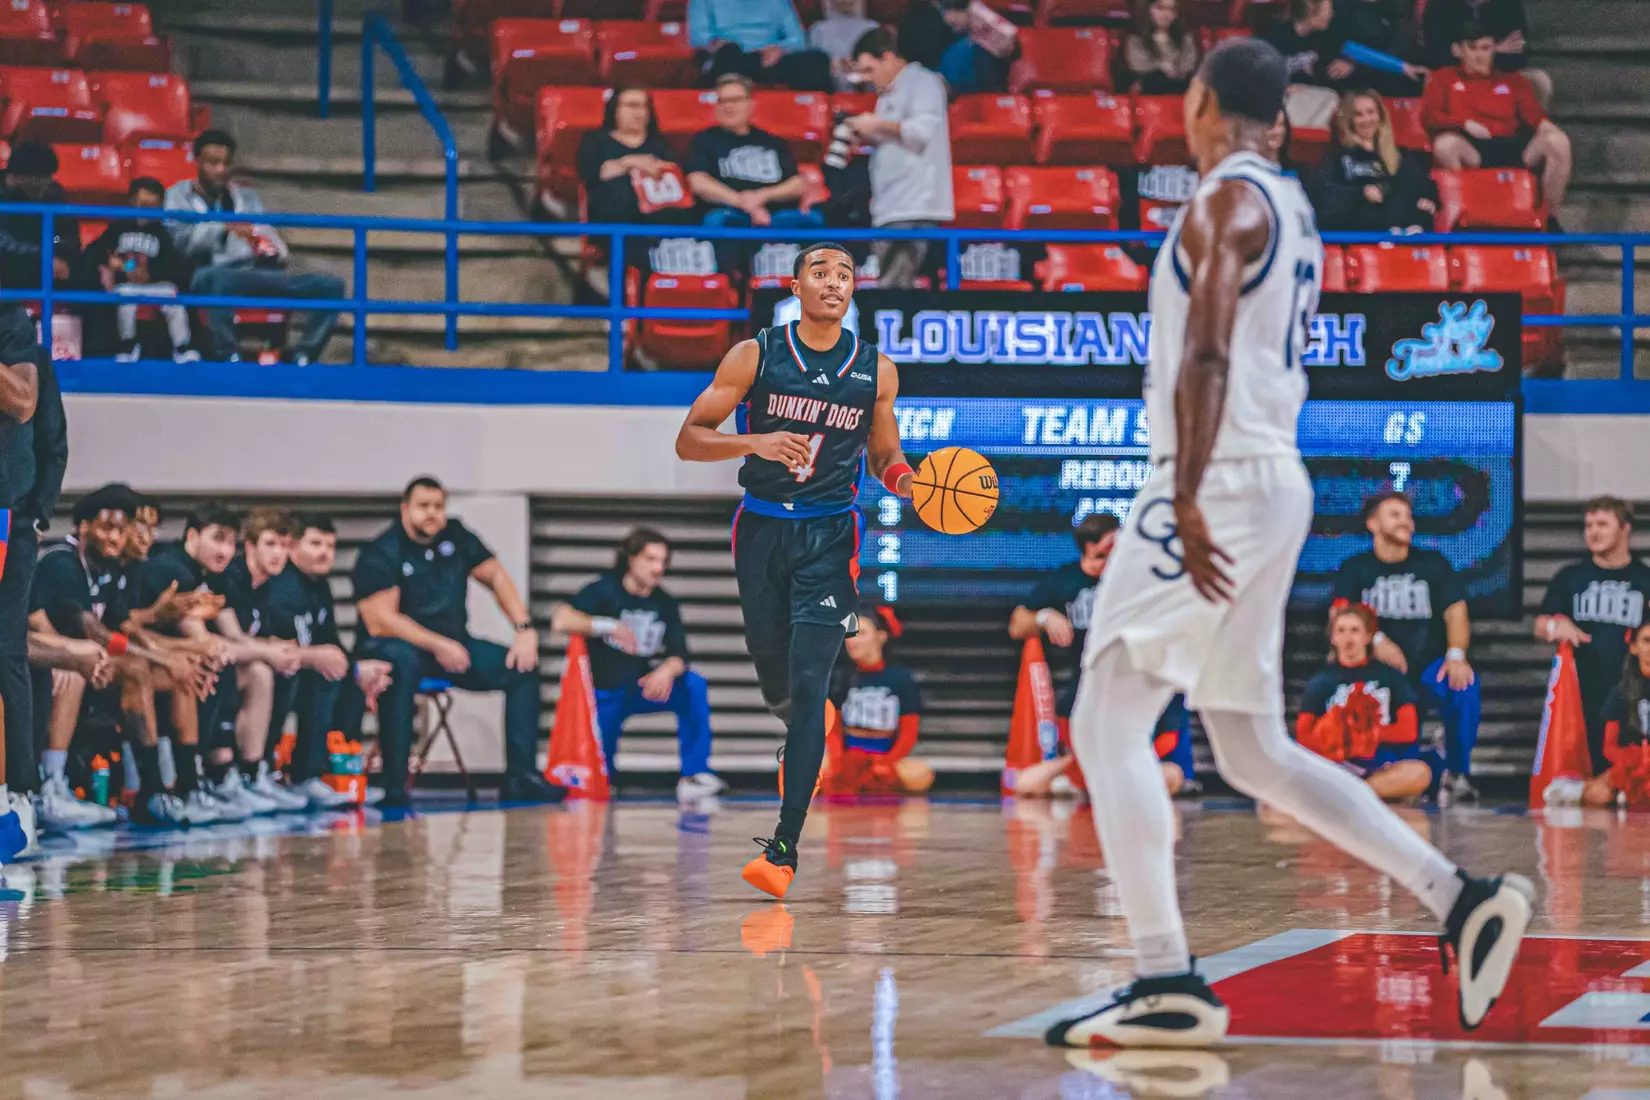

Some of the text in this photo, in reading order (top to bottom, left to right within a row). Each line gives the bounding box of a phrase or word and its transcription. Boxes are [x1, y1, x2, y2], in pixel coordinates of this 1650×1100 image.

[767, 393, 865, 431] DUNKIN' DOGS
[1022, 406, 1128, 445] TEAM
[788, 431, 826, 483] 4
[1389, 461, 1411, 492] 7
[877, 496, 901, 526] 3
[877, 533, 901, 564] 2
[877, 571, 898, 601] 1
